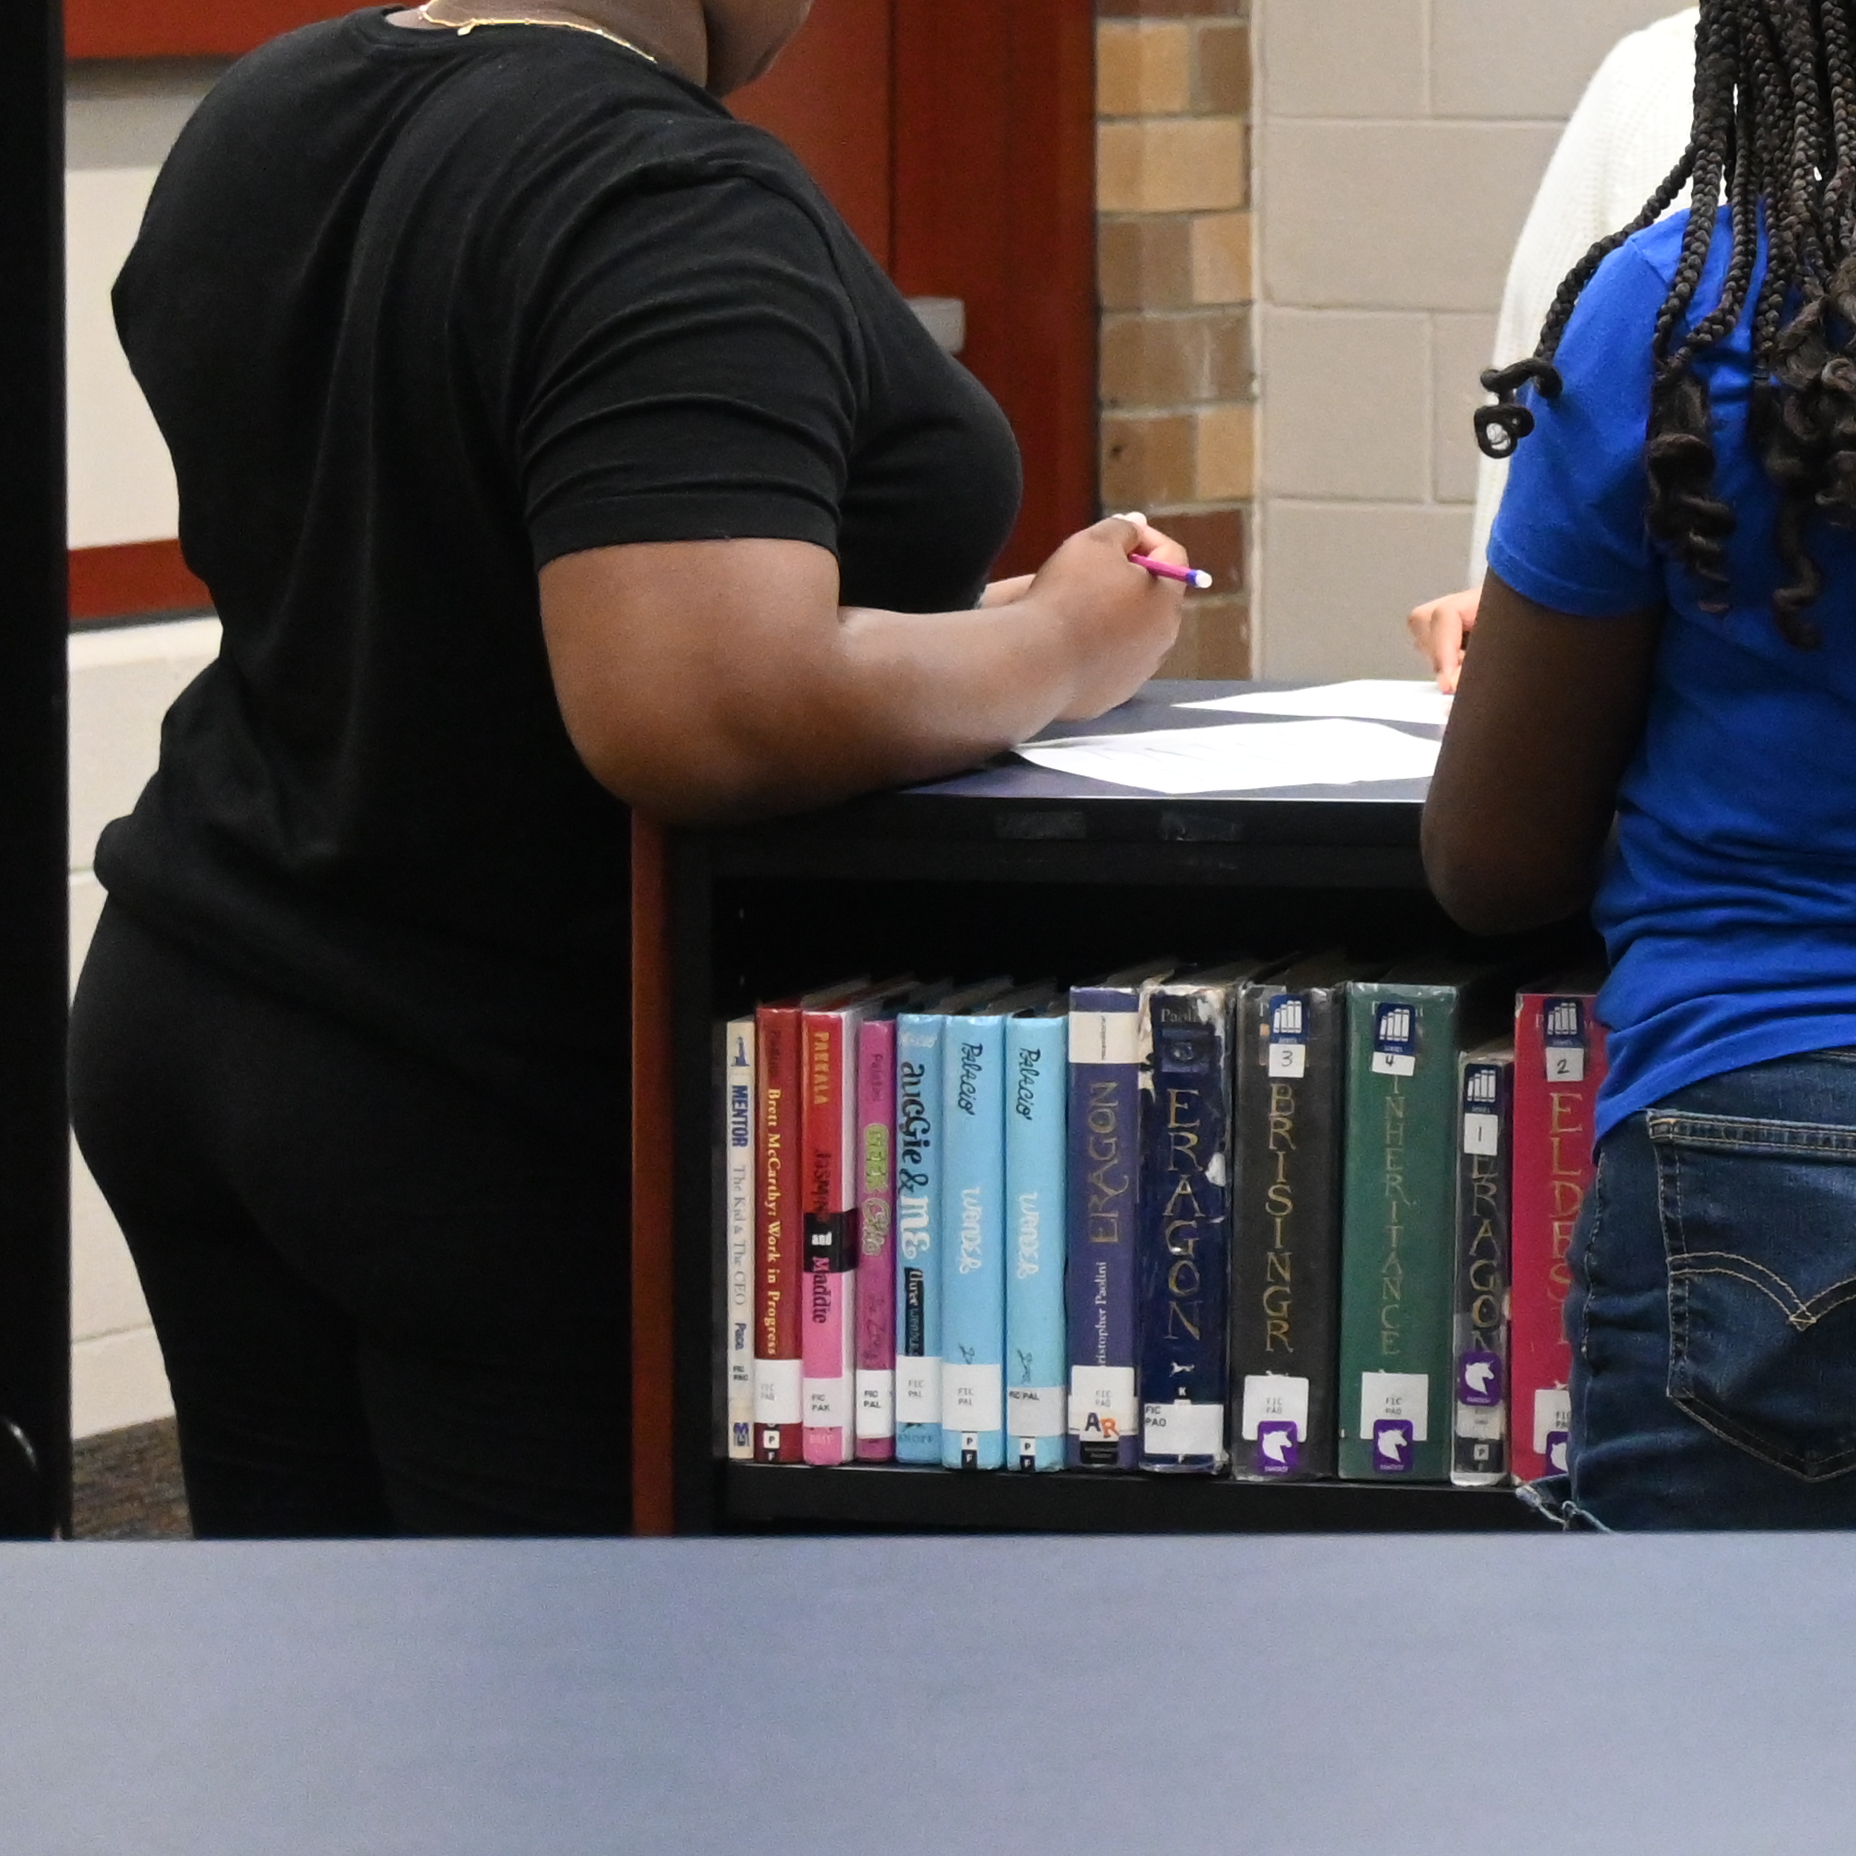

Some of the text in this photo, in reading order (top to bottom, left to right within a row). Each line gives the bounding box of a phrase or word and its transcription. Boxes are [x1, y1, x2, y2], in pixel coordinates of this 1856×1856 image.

[1281, 1050, 1294, 1067] 3
[732, 1086, 748, 1147] MENTOR
[734, 1166, 745, 1192] The
[1087, 1080, 1129, 1243] ERAGON
[734, 1197, 745, 1220] Kid
[768, 1089, 780, 1355] Brett McCarthy: Work in Progress
[1163, 1088, 1201, 1341] ERAGON
[1262, 1083, 1296, 1353] BRISINGR
[1379, 1075, 1418, 1356] INHERITANCE
[734, 1240, 745, 1266] The
[811, 1233, 832, 1246] and
[1469, 1156, 1502, 1353] ERAGON
[734, 1271, 745, 1305] CEO
